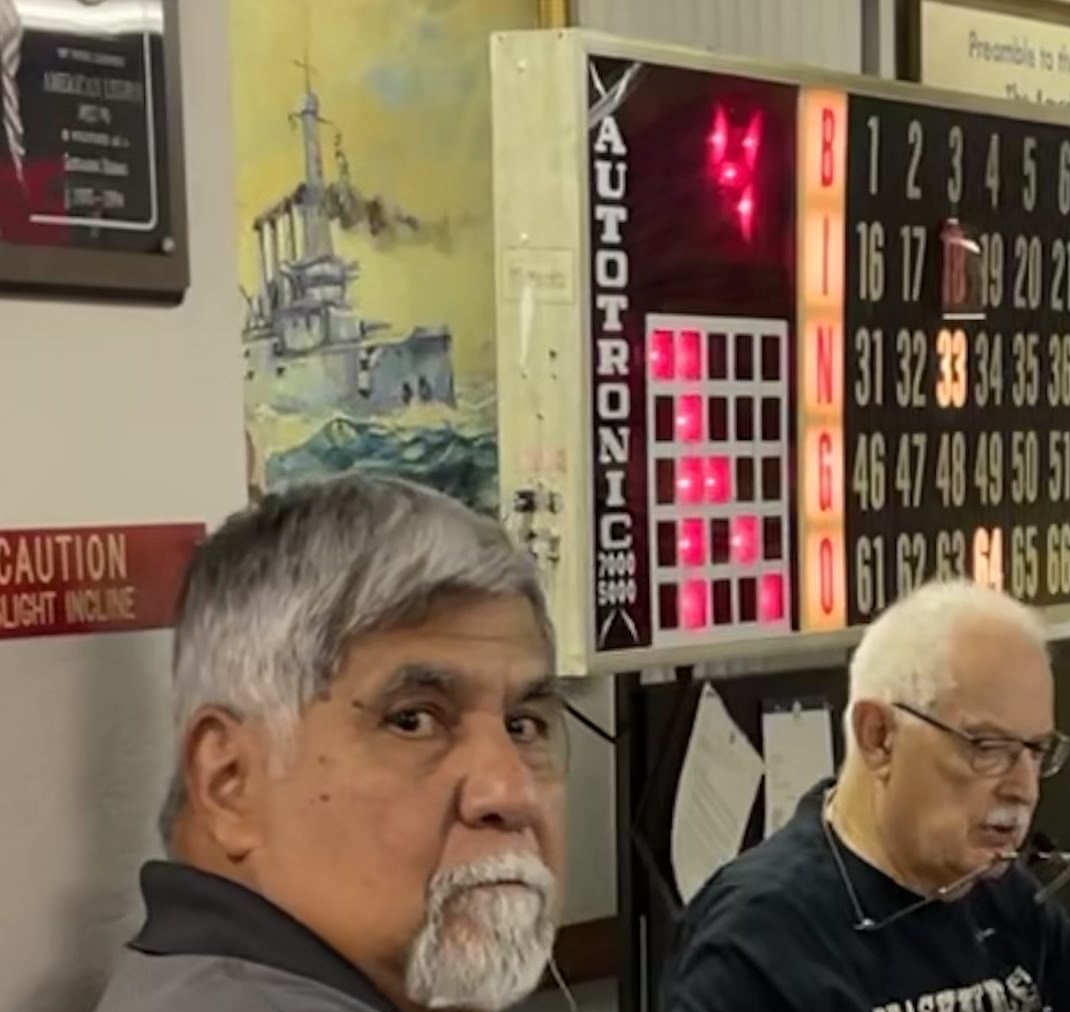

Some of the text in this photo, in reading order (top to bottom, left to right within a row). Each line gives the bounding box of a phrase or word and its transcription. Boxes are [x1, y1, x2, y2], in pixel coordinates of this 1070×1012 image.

[968, 30, 1036, 68] Preamble
[1039, 46, 1053, 70] to
[868, 116, 880, 195] 1
[907, 120, 923, 199] 2
[948, 126, 964, 203] 3
[985, 133, 999, 209] 4
[1023, 137, 1037, 211] 5
[857, 221, 884, 301] 16
[901, 225, 926, 300] 17
[980, 232, 1002, 308] 19
[1014, 235, 1042, 309] 20
[594, 115, 632, 549] AUTOTRONIC
[816, 107, 836, 615] BINGO
[855, 327, 883, 406] 31
[897, 329, 926, 407] 32
[936, 328, 967, 408] 33
[975, 331, 1001, 407] 34
[1012, 333, 1039, 407] 35
[853, 432, 885, 510] 46
[895, 432, 926, 507] 47
[936, 431, 966, 507] 48
[975, 431, 1002, 506] 49
[1012, 431, 1038, 504] 50
[0, 533, 127, 585] CAUTION
[857, 535, 884, 614] 61
[897, 533, 926, 597] 62
[973, 526, 1002, 591] 64
[1012, 525, 1038, 598] 65
[0, 586, 136, 628] LIGHT INCLINE
